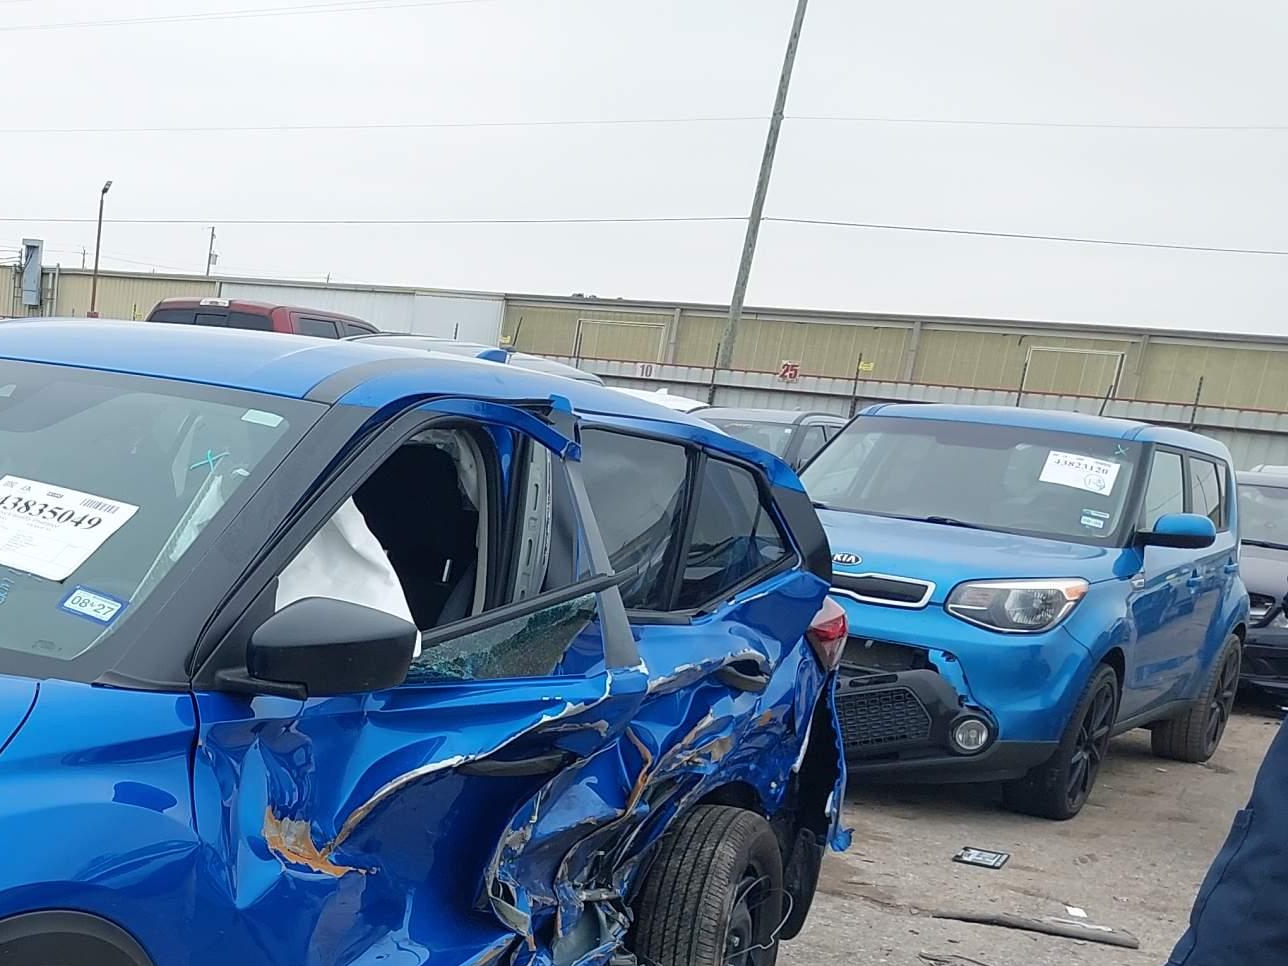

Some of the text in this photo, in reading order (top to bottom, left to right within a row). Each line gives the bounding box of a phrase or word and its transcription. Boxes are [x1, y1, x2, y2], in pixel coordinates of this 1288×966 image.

[639, 364, 653, 378] 10
[779, 363, 799, 380] 25
[833, 553, 856, 563] KIA
[70, 595, 115, 617] 08 27
